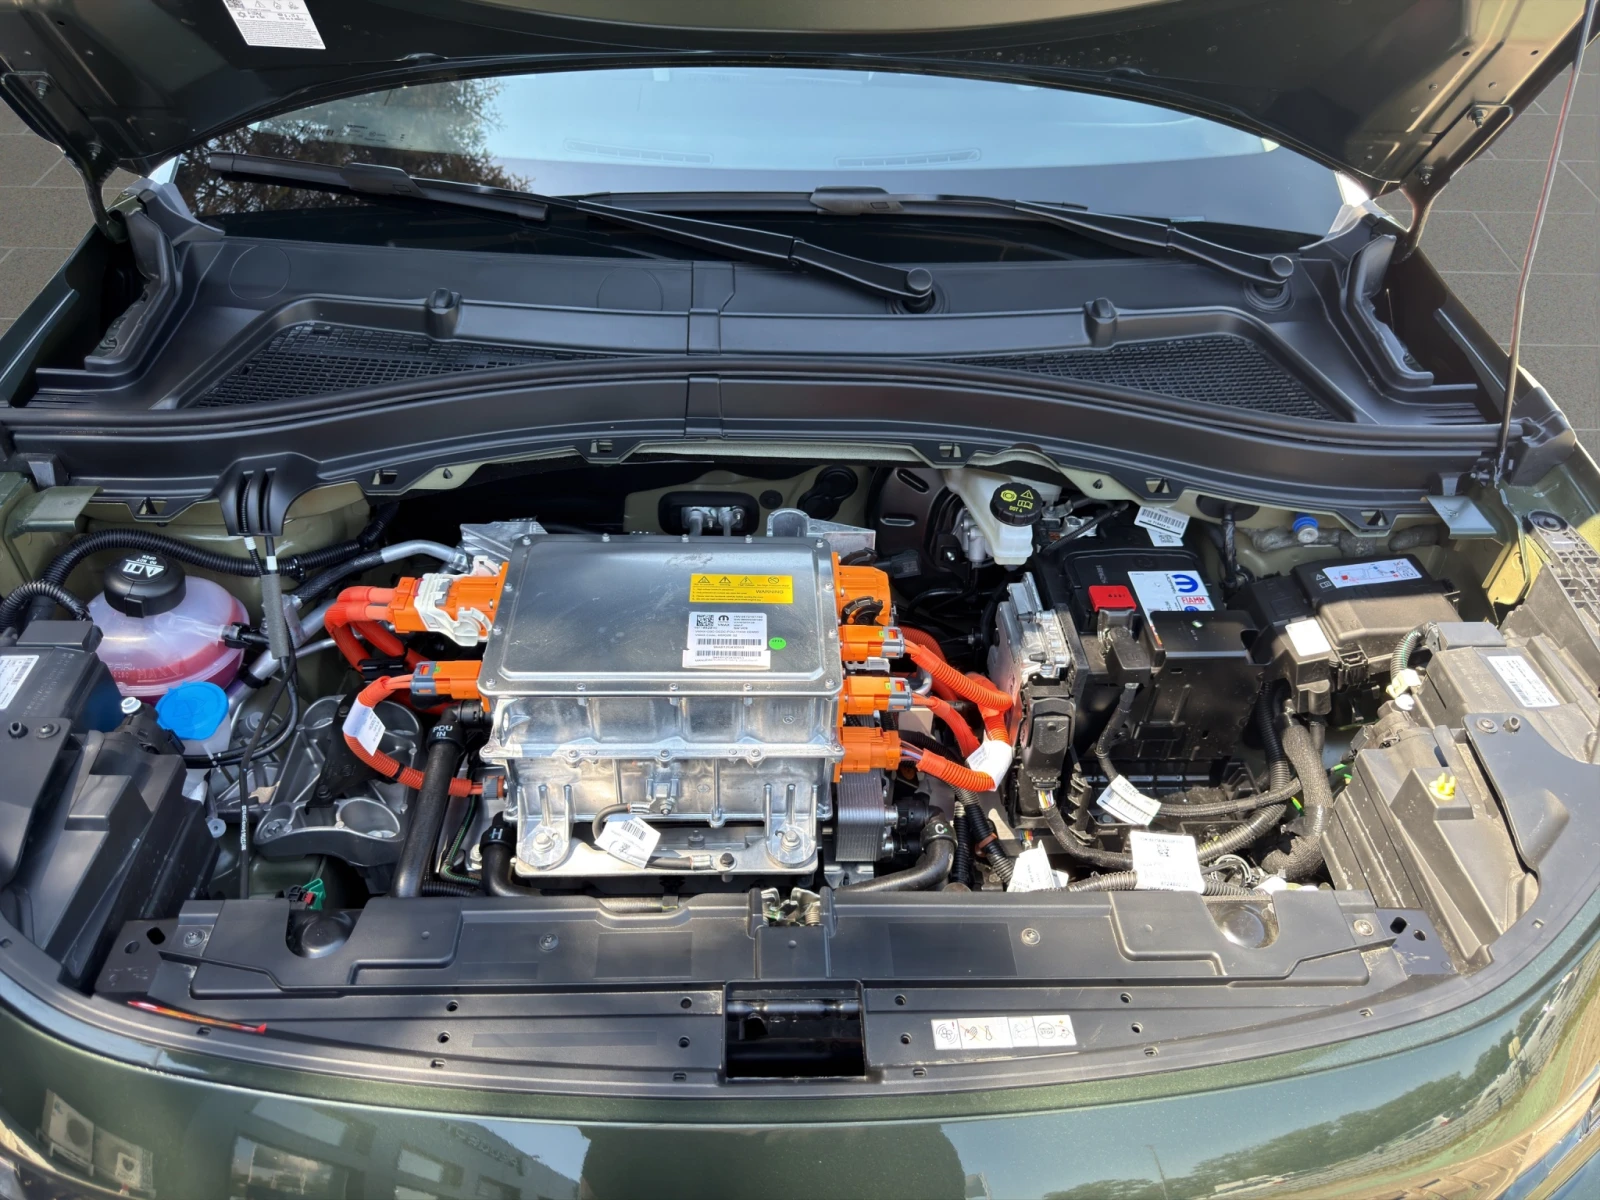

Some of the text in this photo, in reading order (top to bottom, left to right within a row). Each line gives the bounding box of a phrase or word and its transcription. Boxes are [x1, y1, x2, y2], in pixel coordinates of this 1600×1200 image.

[1181, 596, 1207, 604] FIAMM
[491, 828, 503, 840] H
[934, 823, 945, 835] C
